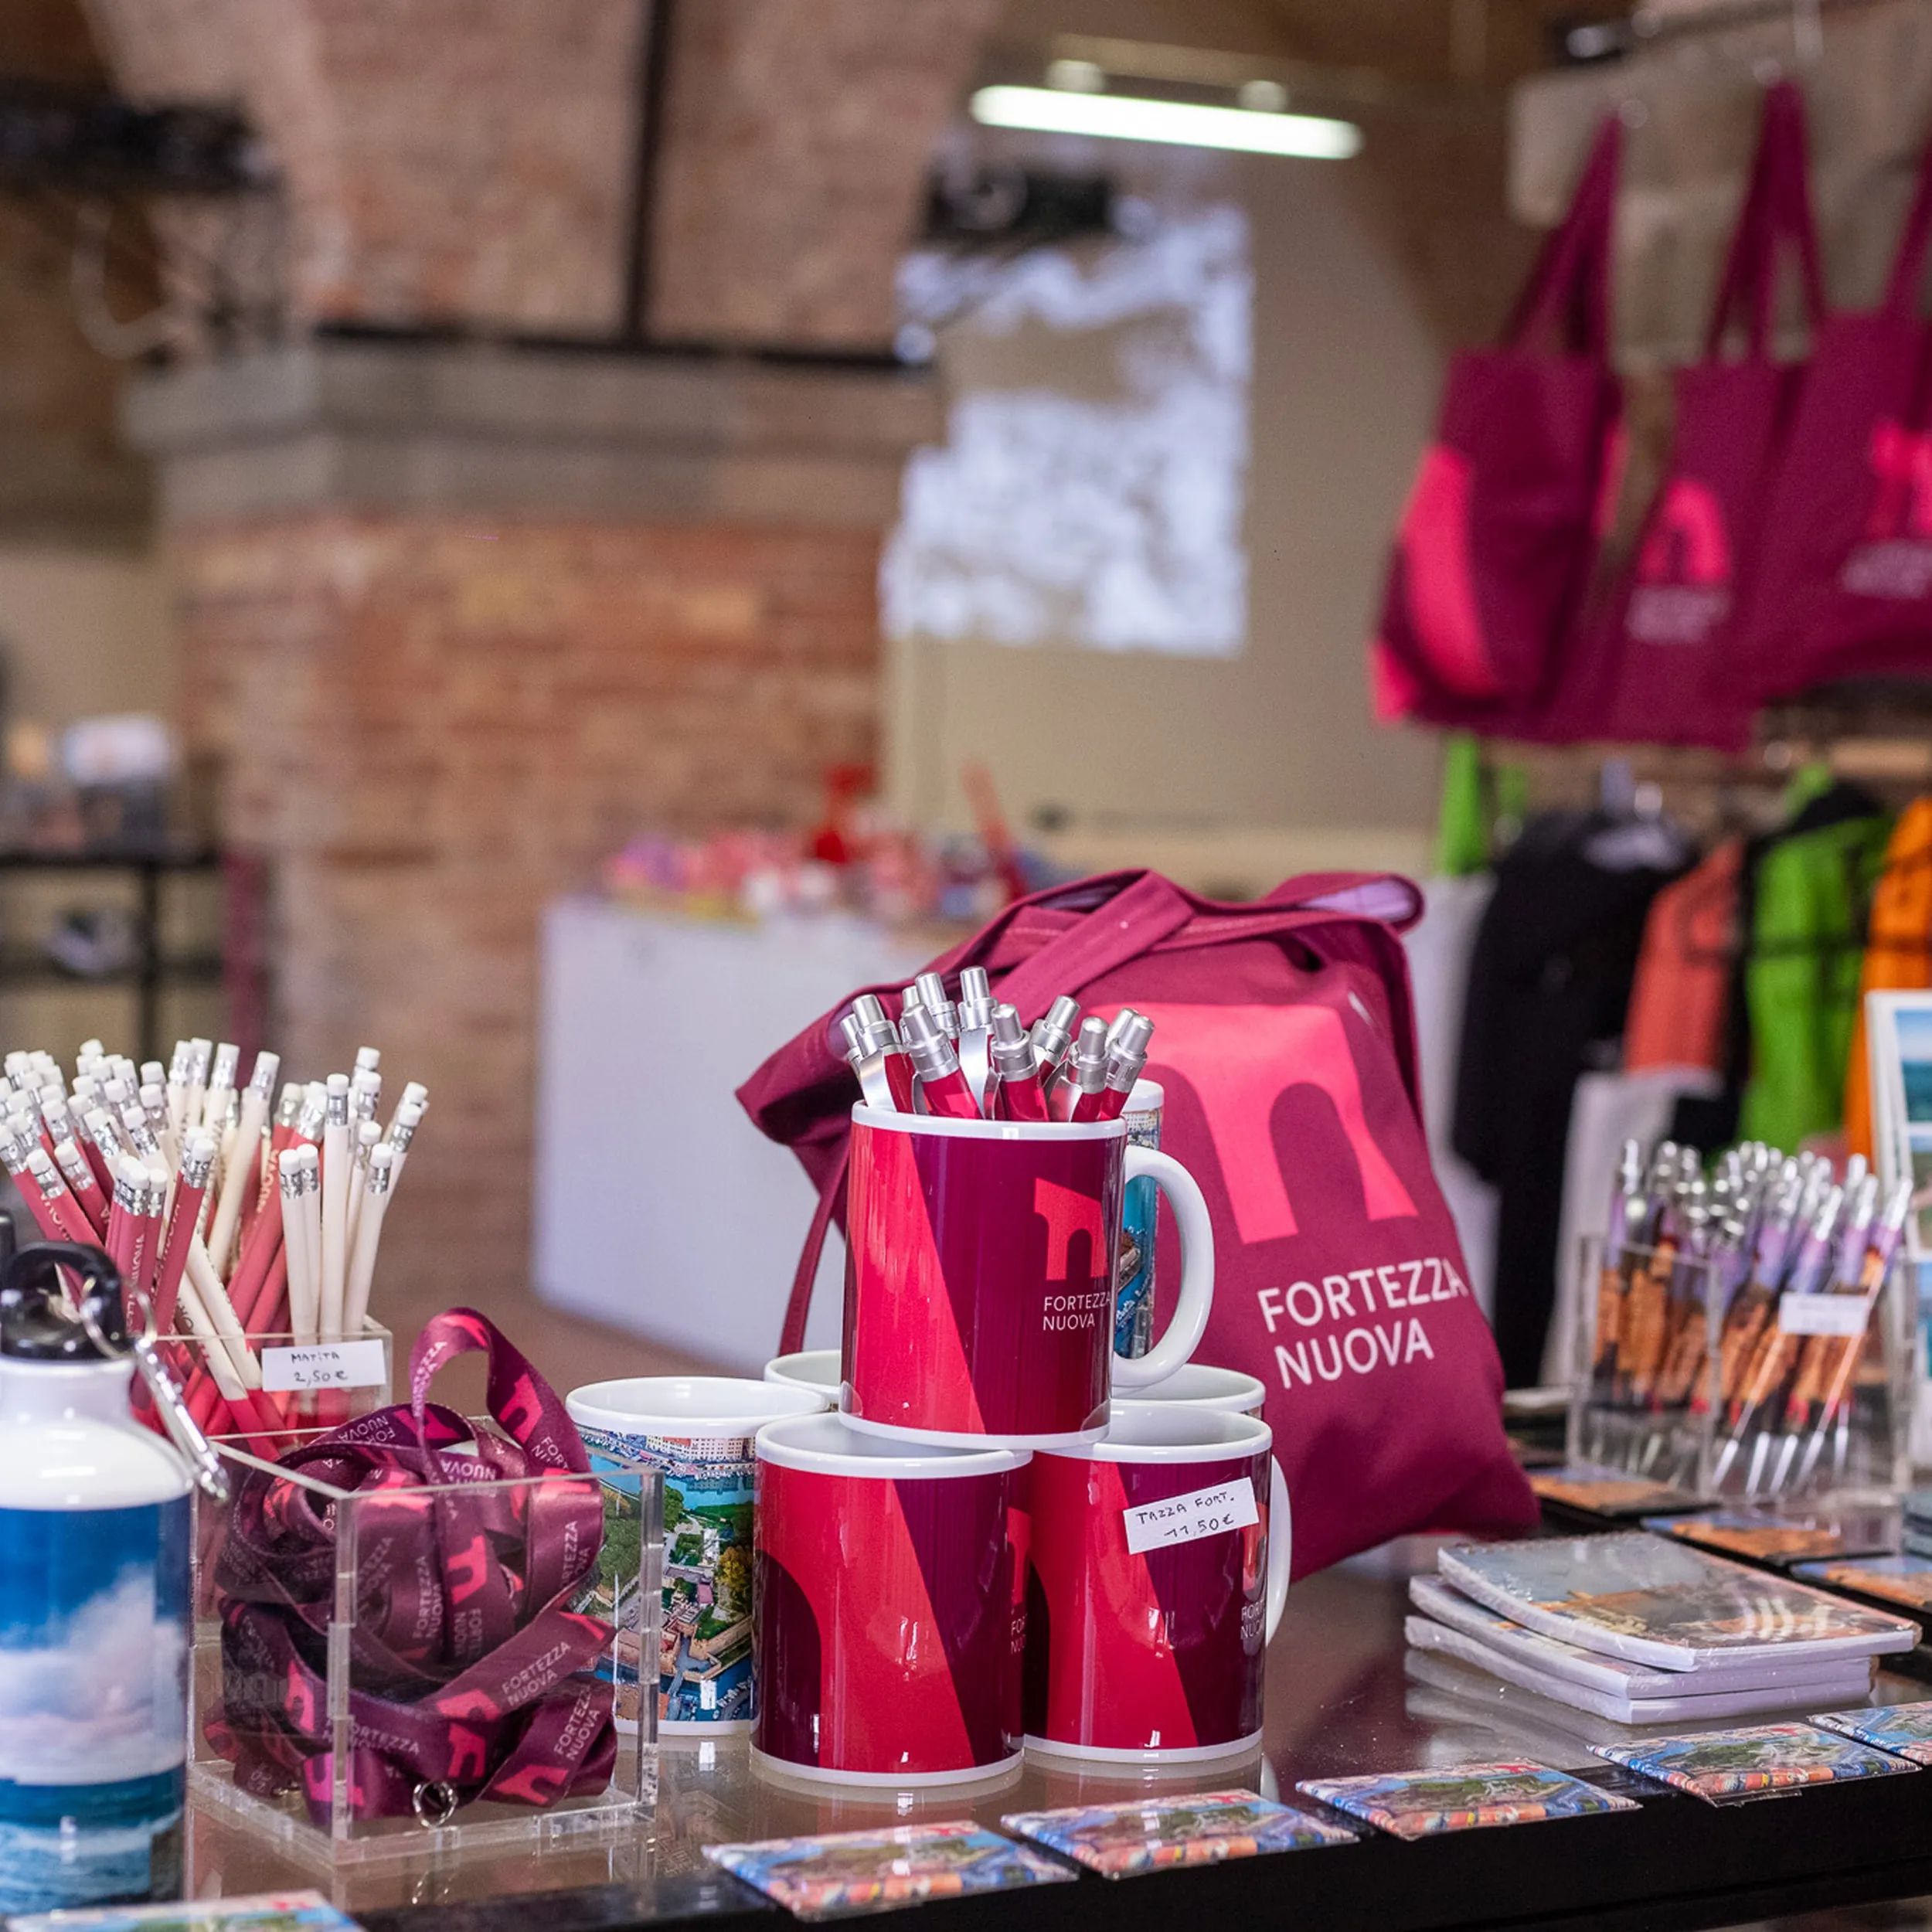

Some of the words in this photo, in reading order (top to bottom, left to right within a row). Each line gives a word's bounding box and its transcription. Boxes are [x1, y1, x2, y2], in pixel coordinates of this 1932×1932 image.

[1043, 1291, 1112, 1311] FORTEZZA
[1257, 1257, 1468, 1333] FORTEZZA
[1043, 1313, 1096, 1331] NUOVA
[1274, 1318, 1435, 1389] NUOVA
[1136, 1504, 1187, 1525] TAZZA
[562, 1520, 578, 1580] RTEZZA
[502, 1641, 571, 1695] FORTEZZA
[508, 1668, 558, 1706] NUOVA
[349, 1723, 421, 1755] ORTEZZA
[553, 1683, 592, 1756] FORTEZZ
[566, 1709, 600, 1761] NUOVA
